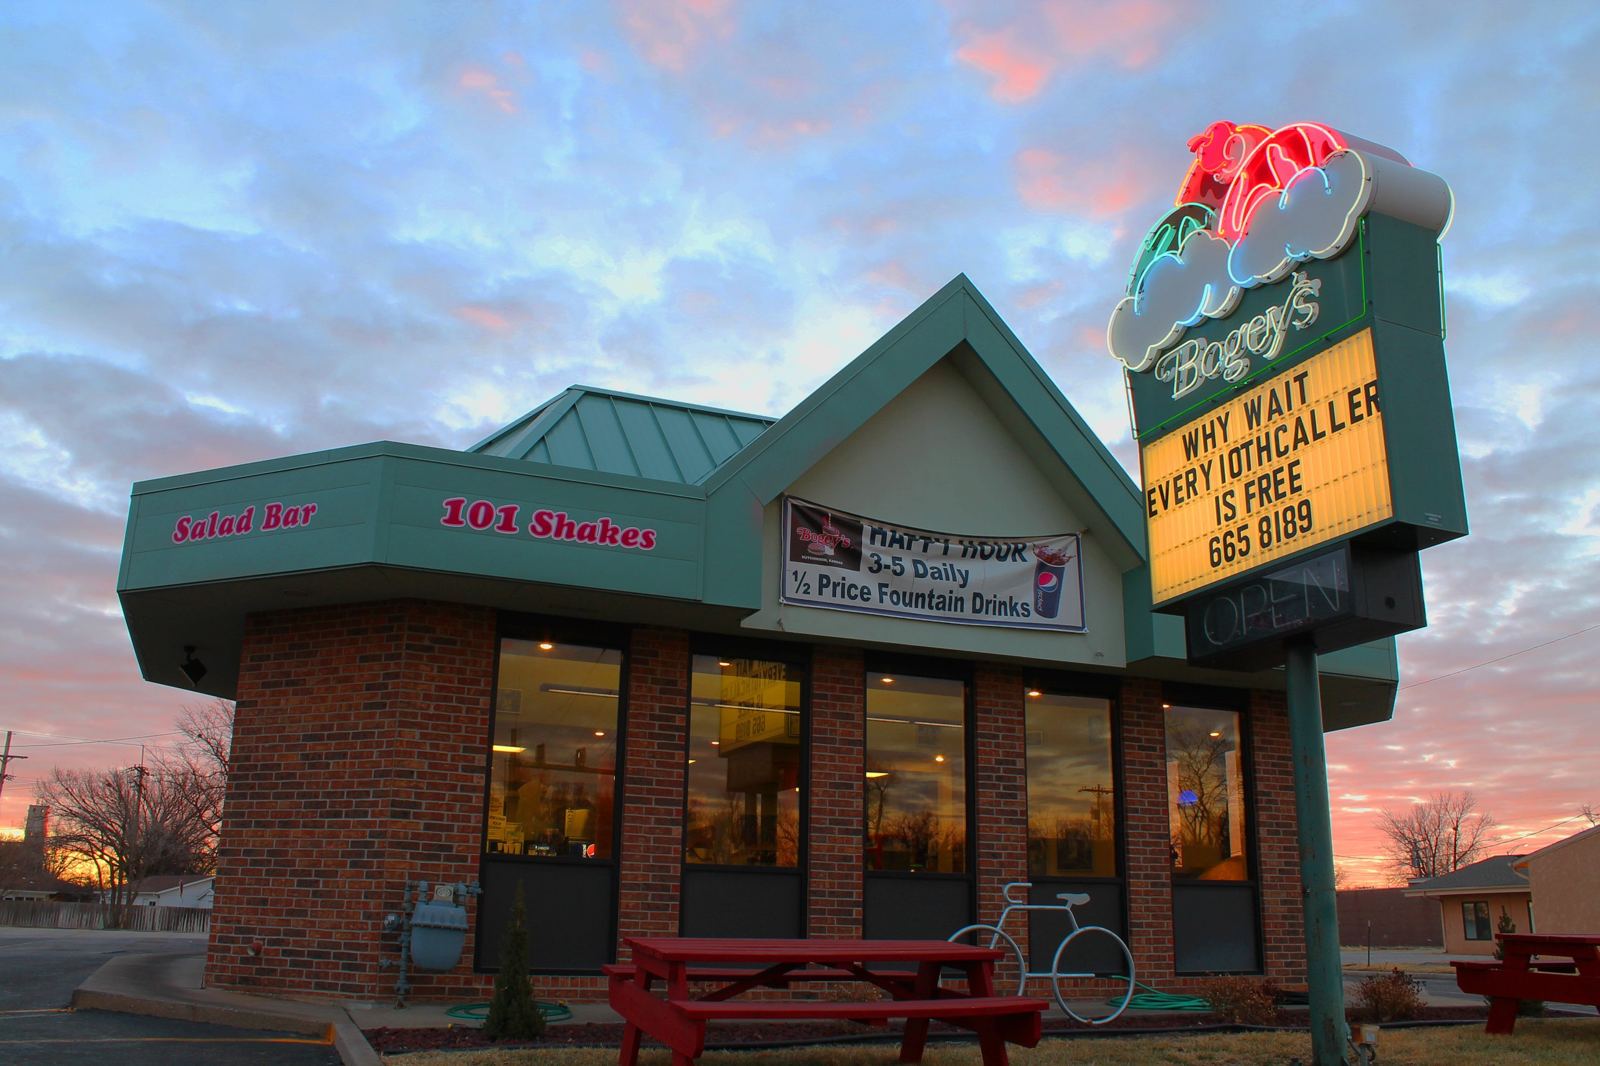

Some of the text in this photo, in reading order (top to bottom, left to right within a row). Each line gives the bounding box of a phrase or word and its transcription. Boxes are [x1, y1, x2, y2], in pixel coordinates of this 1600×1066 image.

[1155, 271, 1321, 400] Bogey's
[1182, 371, 1308, 462] WHY WAIT
[1147, 459, 1213, 518] EVERY
[1215, 459, 1302, 526] IS FREE
[172, 502, 318, 544] Salad Bar
[441, 497, 656, 550] 101 Shakes
[1209, 499, 1313, 568] 665 8189
[818, 573, 871, 602] Price
[878, 582, 965, 613] Fountain
[972, 592, 1031, 618] Drinks
[868, 552, 969, 588] 3-5 Daily
[1204, 559, 1340, 646] OPEN
